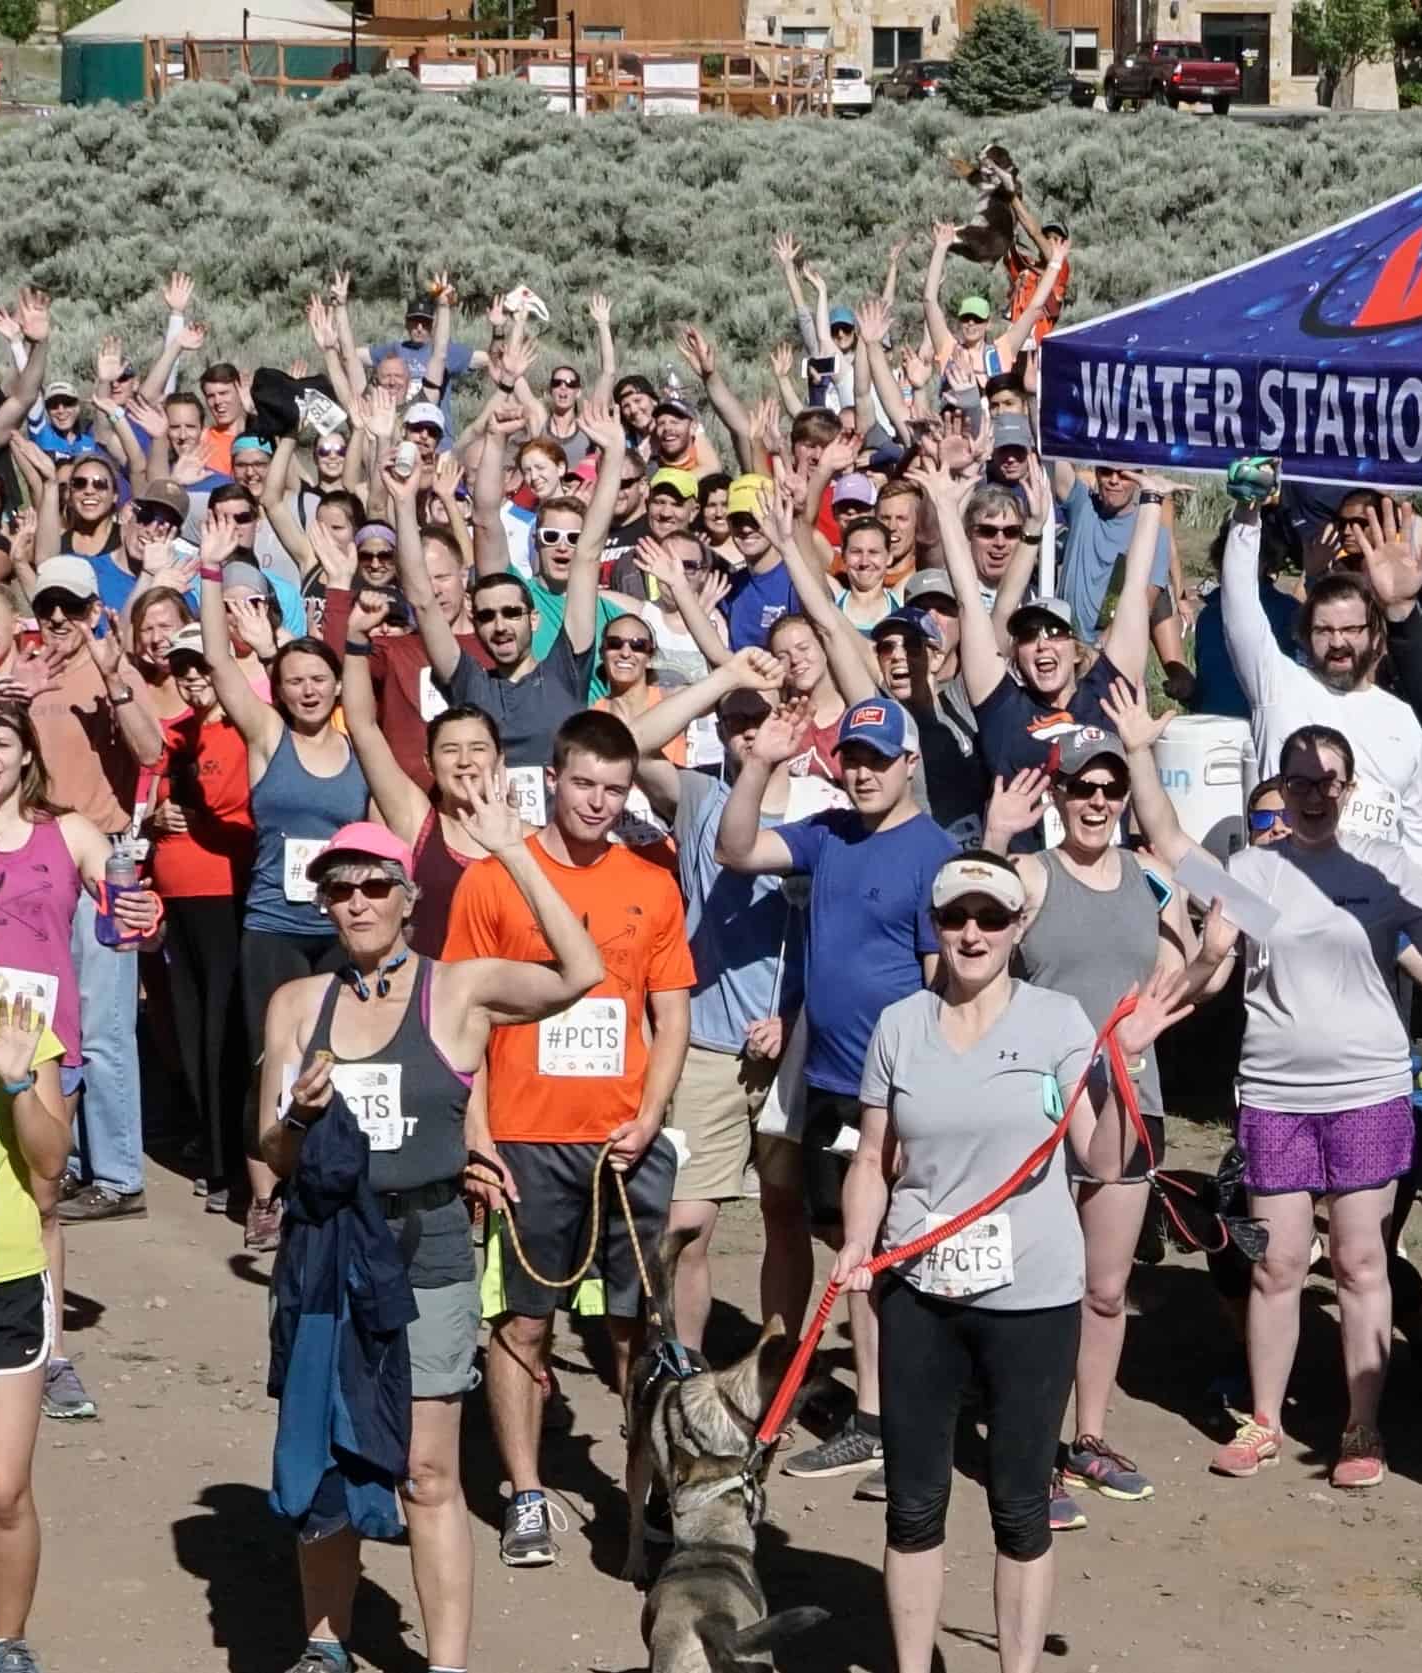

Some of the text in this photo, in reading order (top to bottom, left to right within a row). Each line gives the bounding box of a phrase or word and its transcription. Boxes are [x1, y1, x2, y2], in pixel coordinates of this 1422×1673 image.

[1080, 361, 1245, 449] WATER
[1344, 800, 1395, 827] PCTS
[547, 1027, 618, 1049] #PCTS
[926, 1246, 1002, 1272] #PCTS
